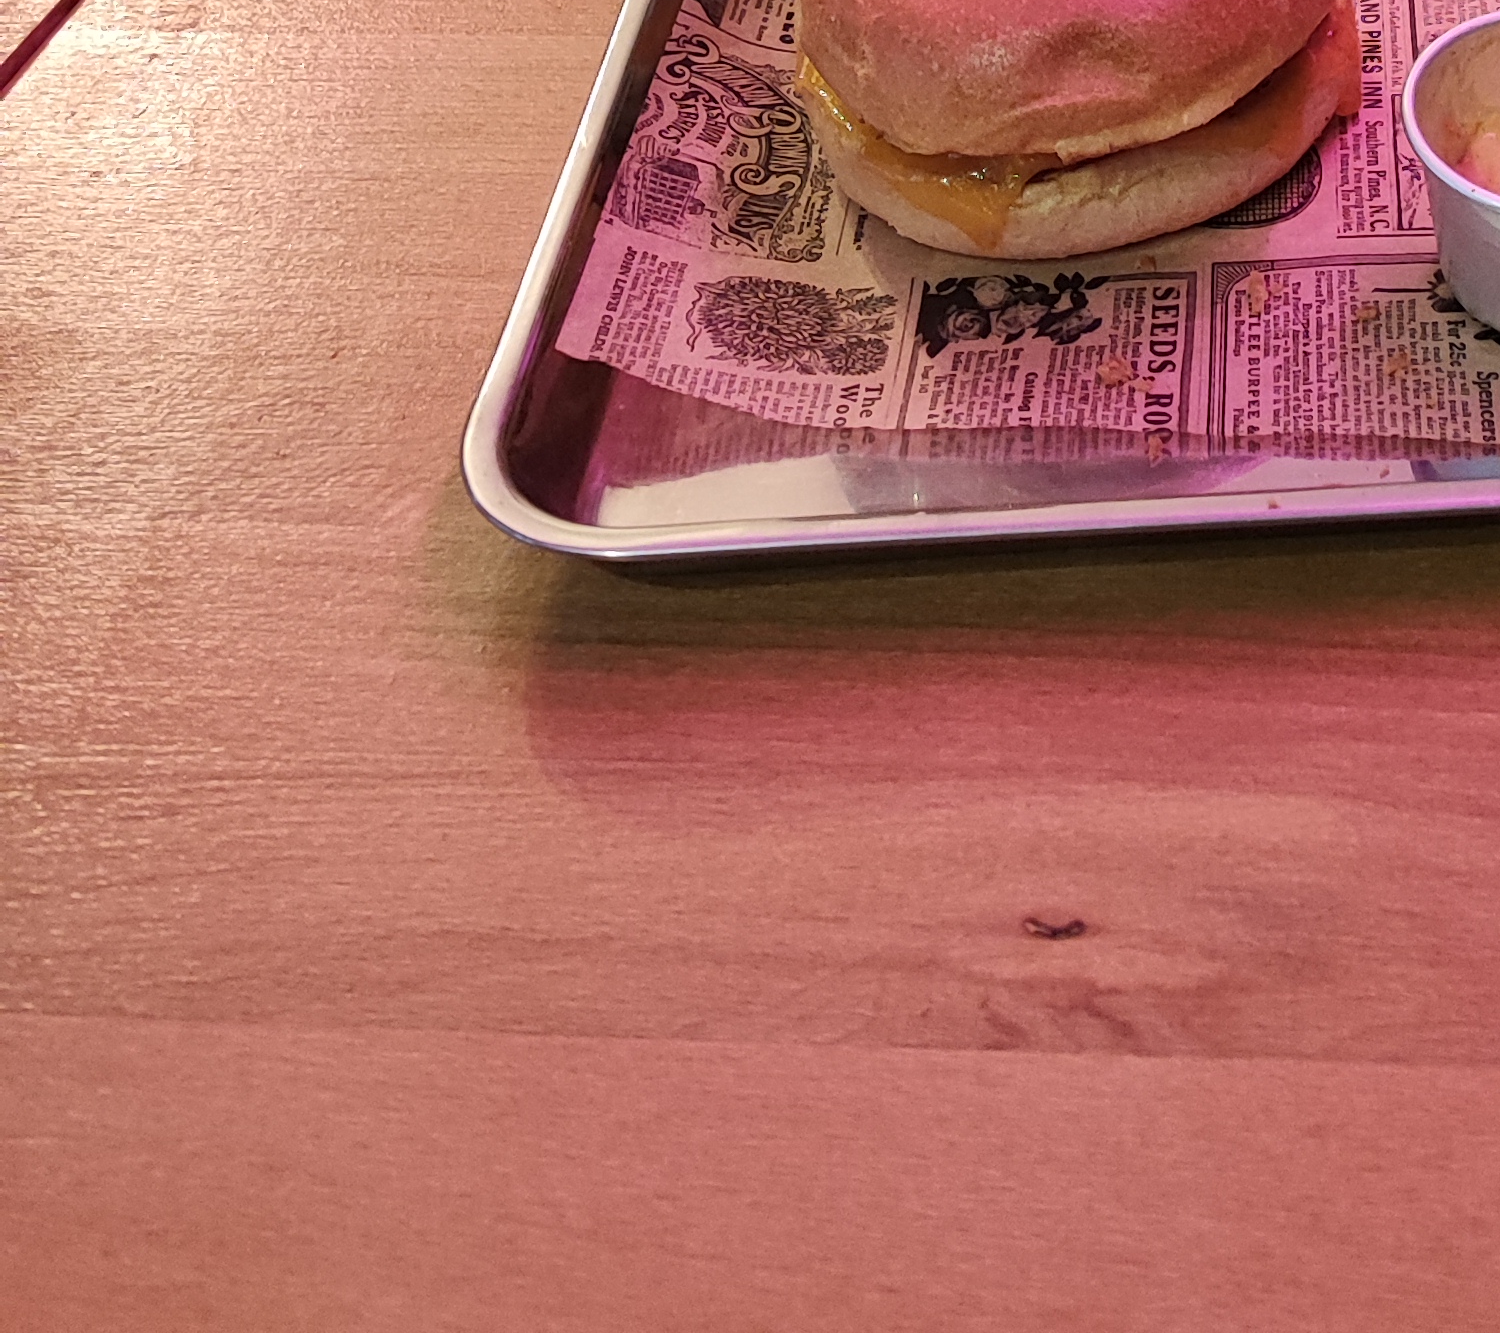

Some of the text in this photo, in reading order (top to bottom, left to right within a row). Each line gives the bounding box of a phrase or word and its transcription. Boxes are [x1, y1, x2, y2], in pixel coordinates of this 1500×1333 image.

[1361, 30, 1384, 74] PINES
[1362, 81, 1384, 110] INN
[1365, 120, 1386, 167] Southern
[617, 245, 638, 278] JOHN
[1447, 319, 1467, 340] For
[859, 382, 884, 419] The
[1247, 357, 1261, 420] BURPEE
[1473, 370, 1499, 443] Spencers
